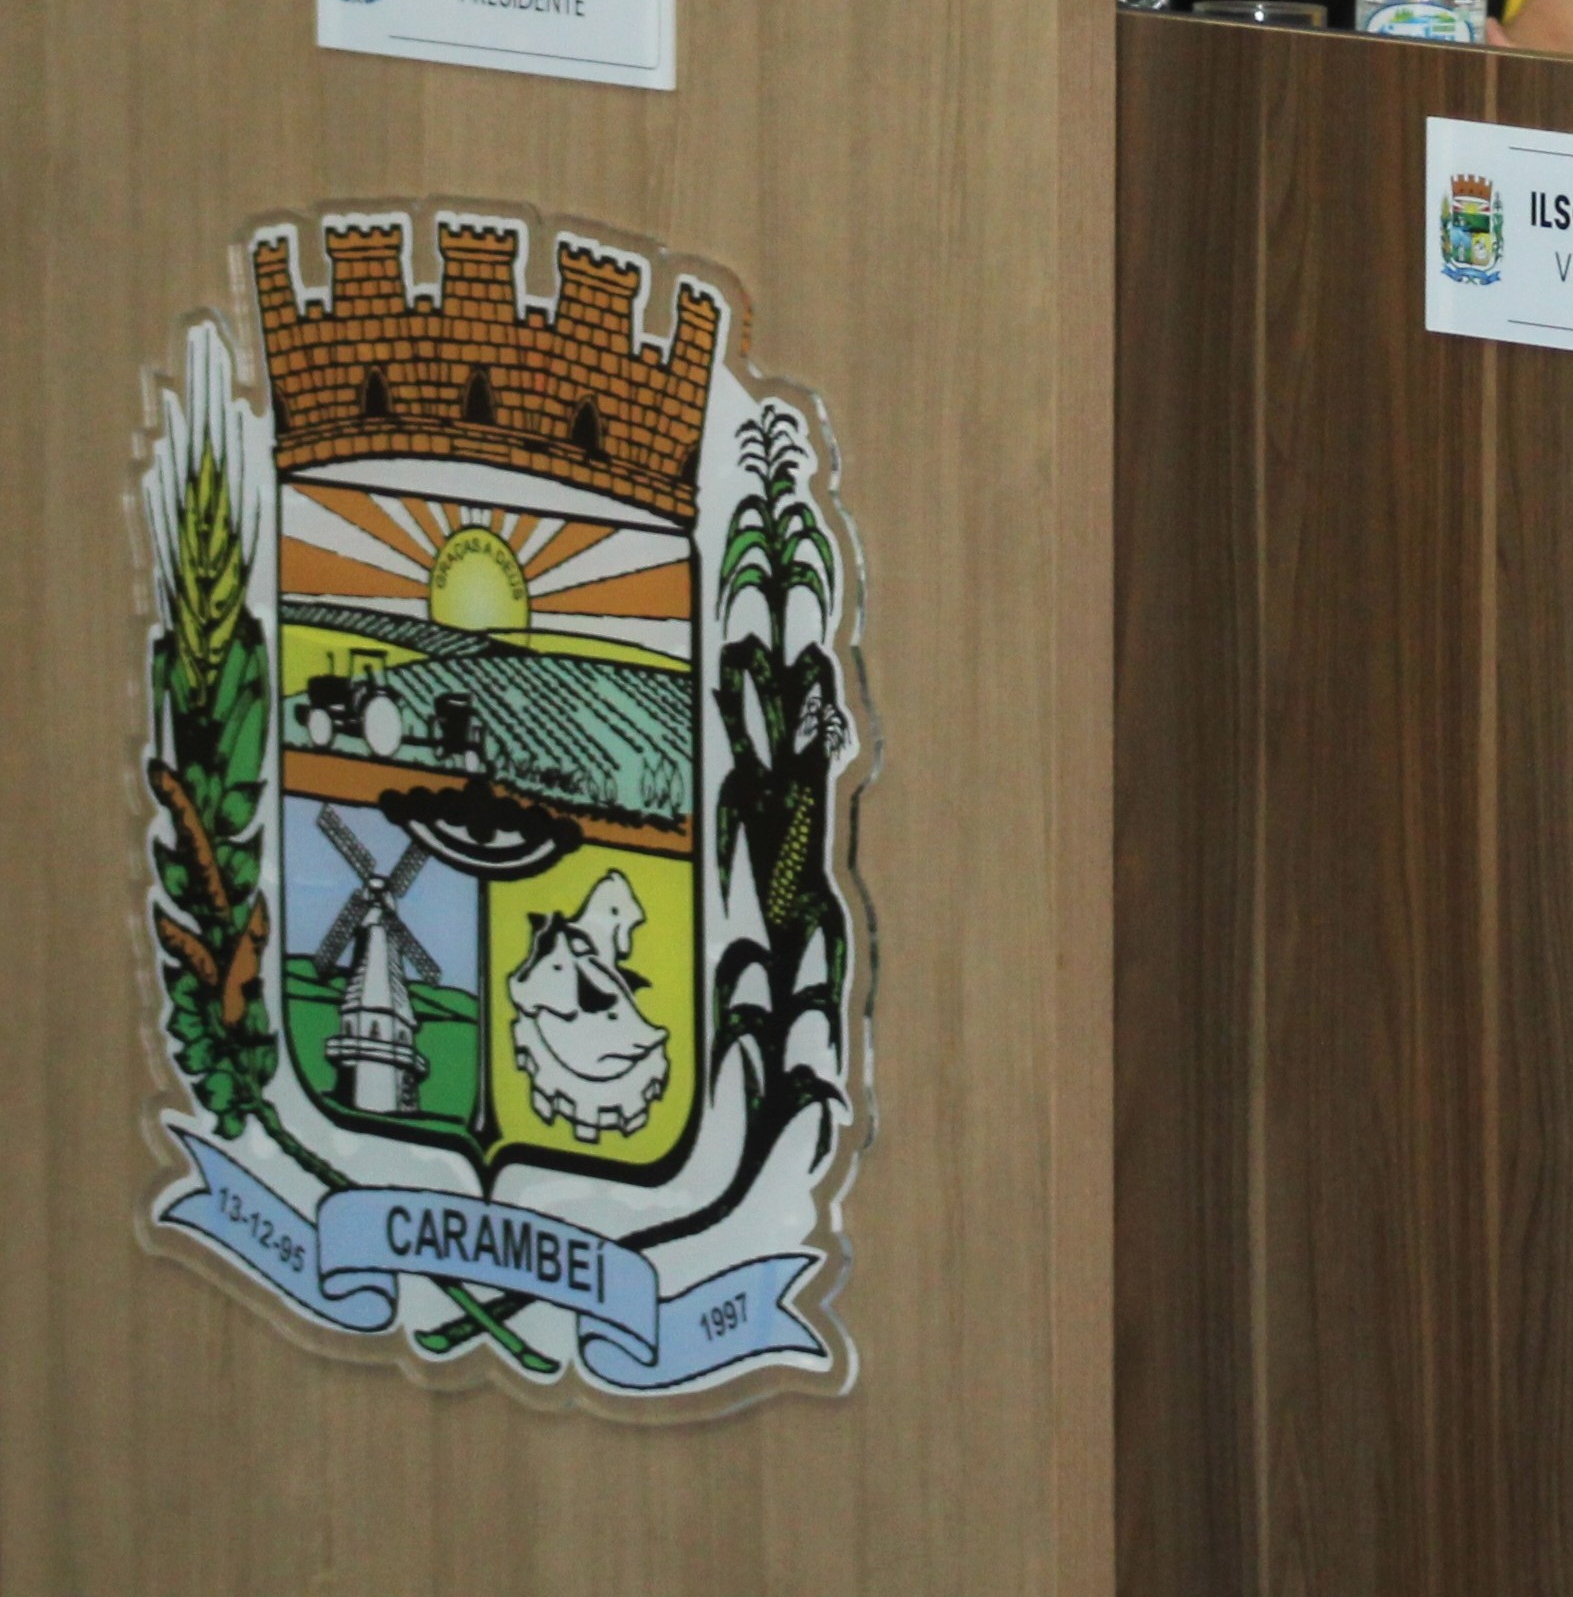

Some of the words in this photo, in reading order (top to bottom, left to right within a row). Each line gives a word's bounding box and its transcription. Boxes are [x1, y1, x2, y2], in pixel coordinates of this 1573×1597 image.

[496, 549, 524, 601] DEUS
[219, 1187, 305, 1273] 13-12-95
[386, 1205, 606, 1304] CARAMBEÍ
[700, 1292, 748, 1341] 1997
